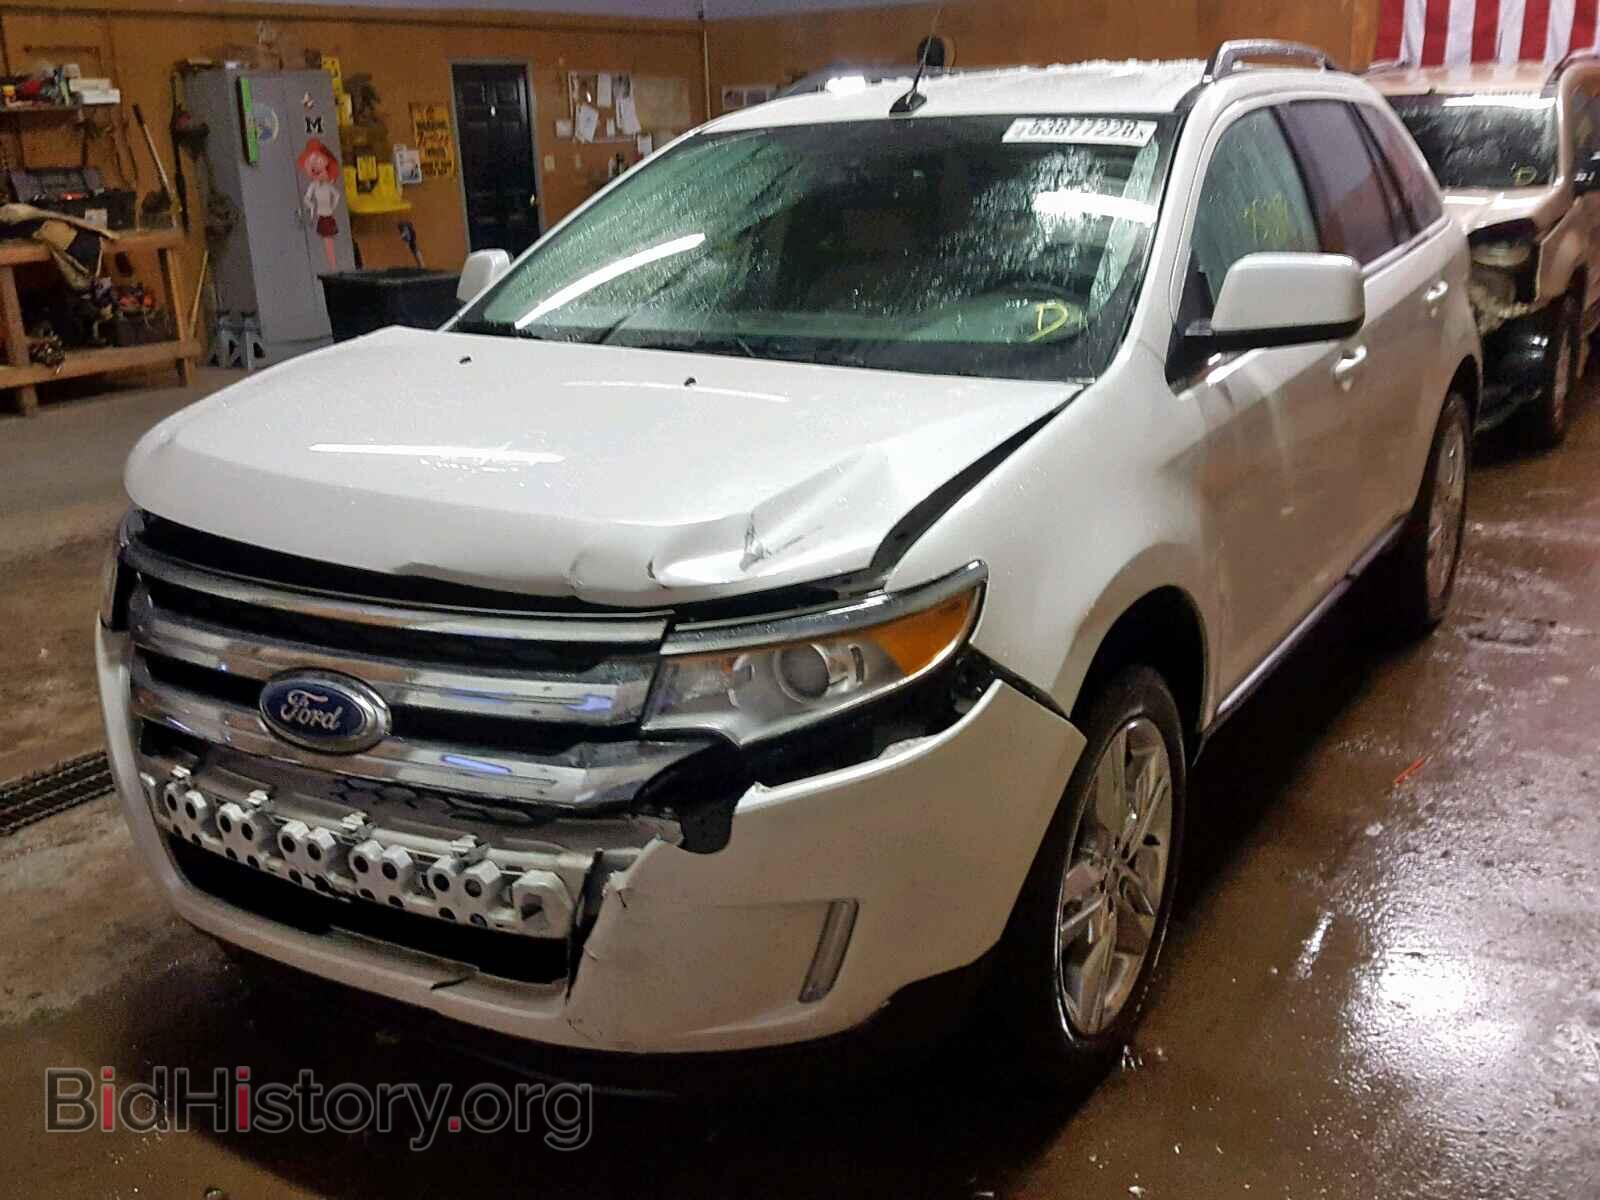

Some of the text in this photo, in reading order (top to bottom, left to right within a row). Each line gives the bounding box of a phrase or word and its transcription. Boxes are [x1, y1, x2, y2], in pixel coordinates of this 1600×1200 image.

[304, 115, 323, 134] M
[1025, 302, 1069, 343] D
[280, 689, 344, 731] Ford
